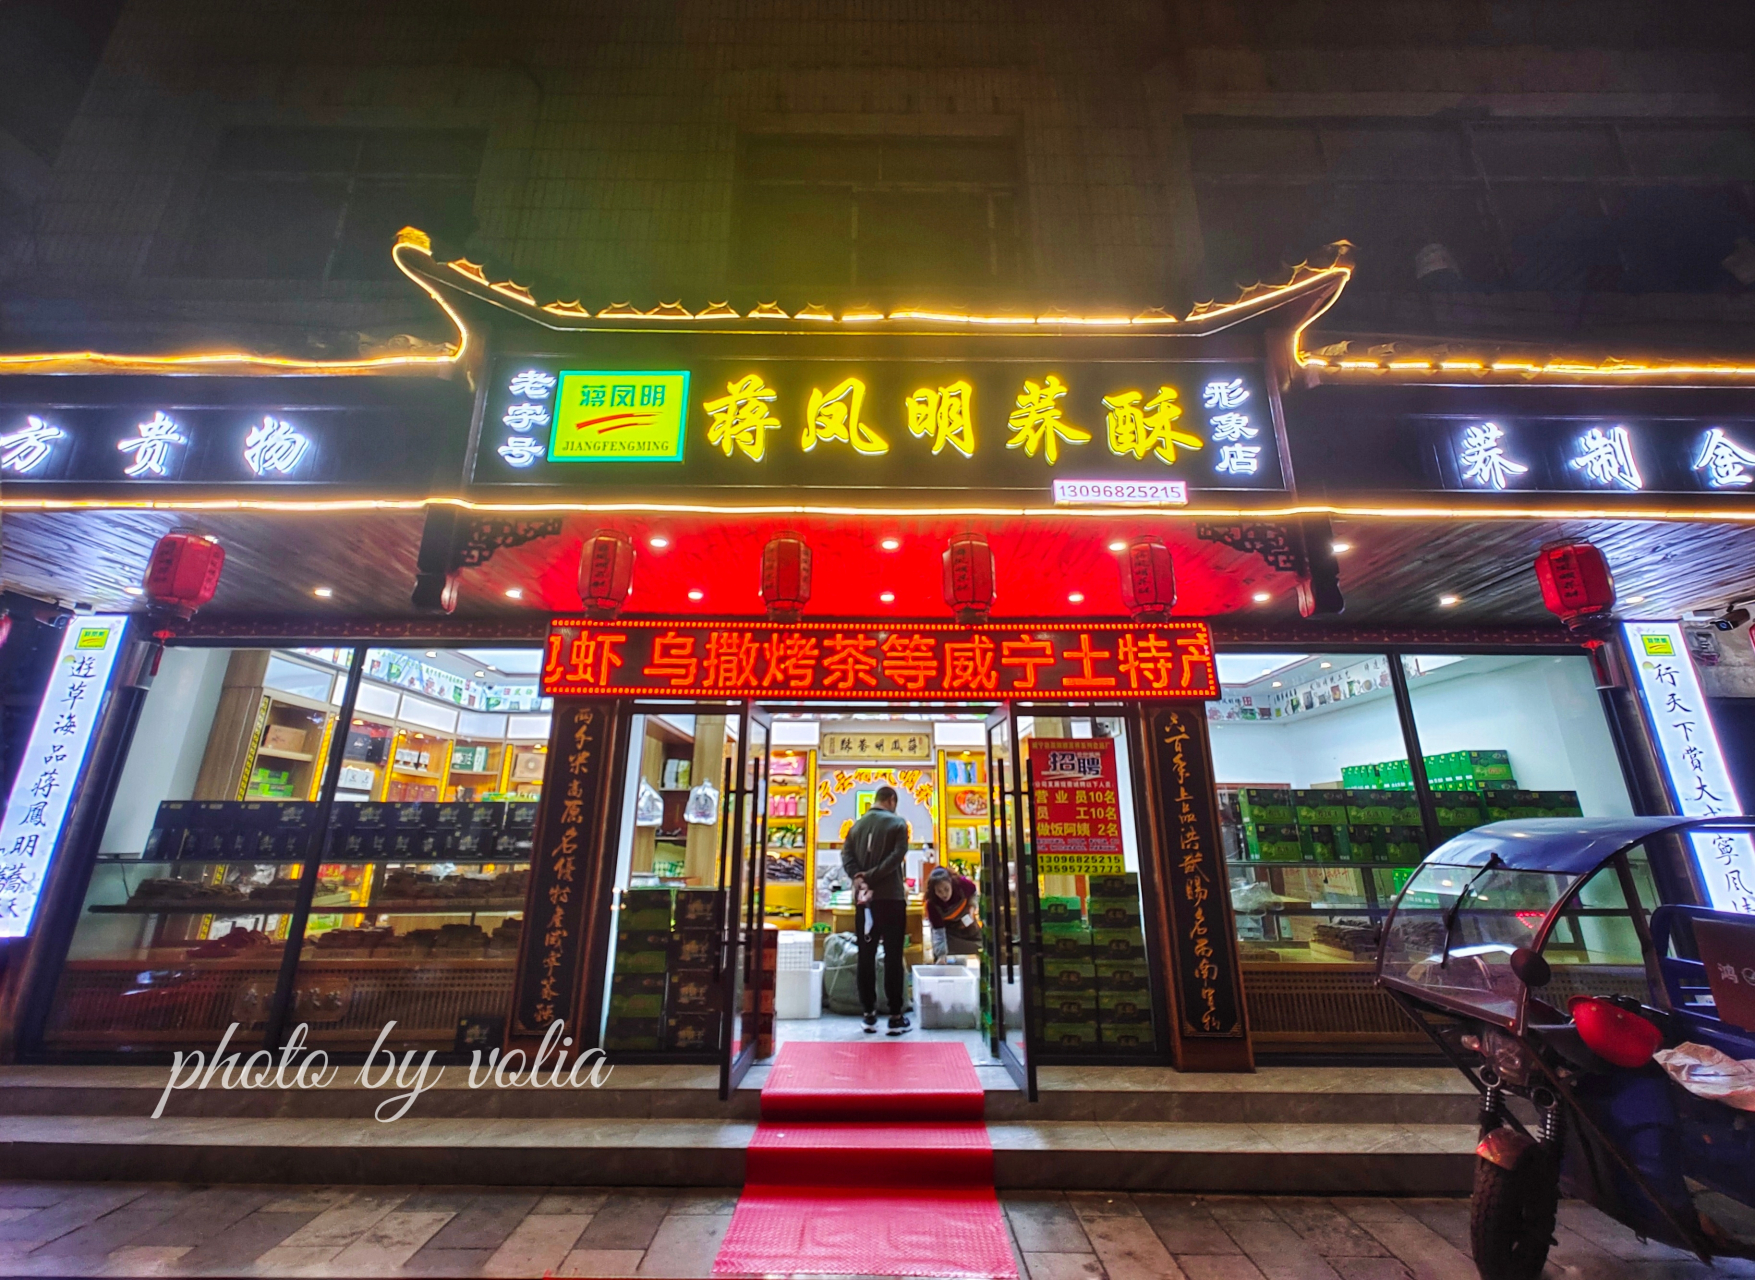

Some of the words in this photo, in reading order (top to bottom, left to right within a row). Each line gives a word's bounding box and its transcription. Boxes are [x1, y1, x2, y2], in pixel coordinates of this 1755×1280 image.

[497, 370, 557, 467] 老字号
[1202, 378, 1262, 475] 形象店
[0, 410, 312, 477] 方贵物
[561, 440, 670, 453] JIANGFENGMING
[1058, 484, 1183, 499] 13096825215
[1049, 751, 1101, 776] 招聘
[1039, 855, 1121, 864] 13096825215
[1039, 864, 1122, 874] 13595723773
